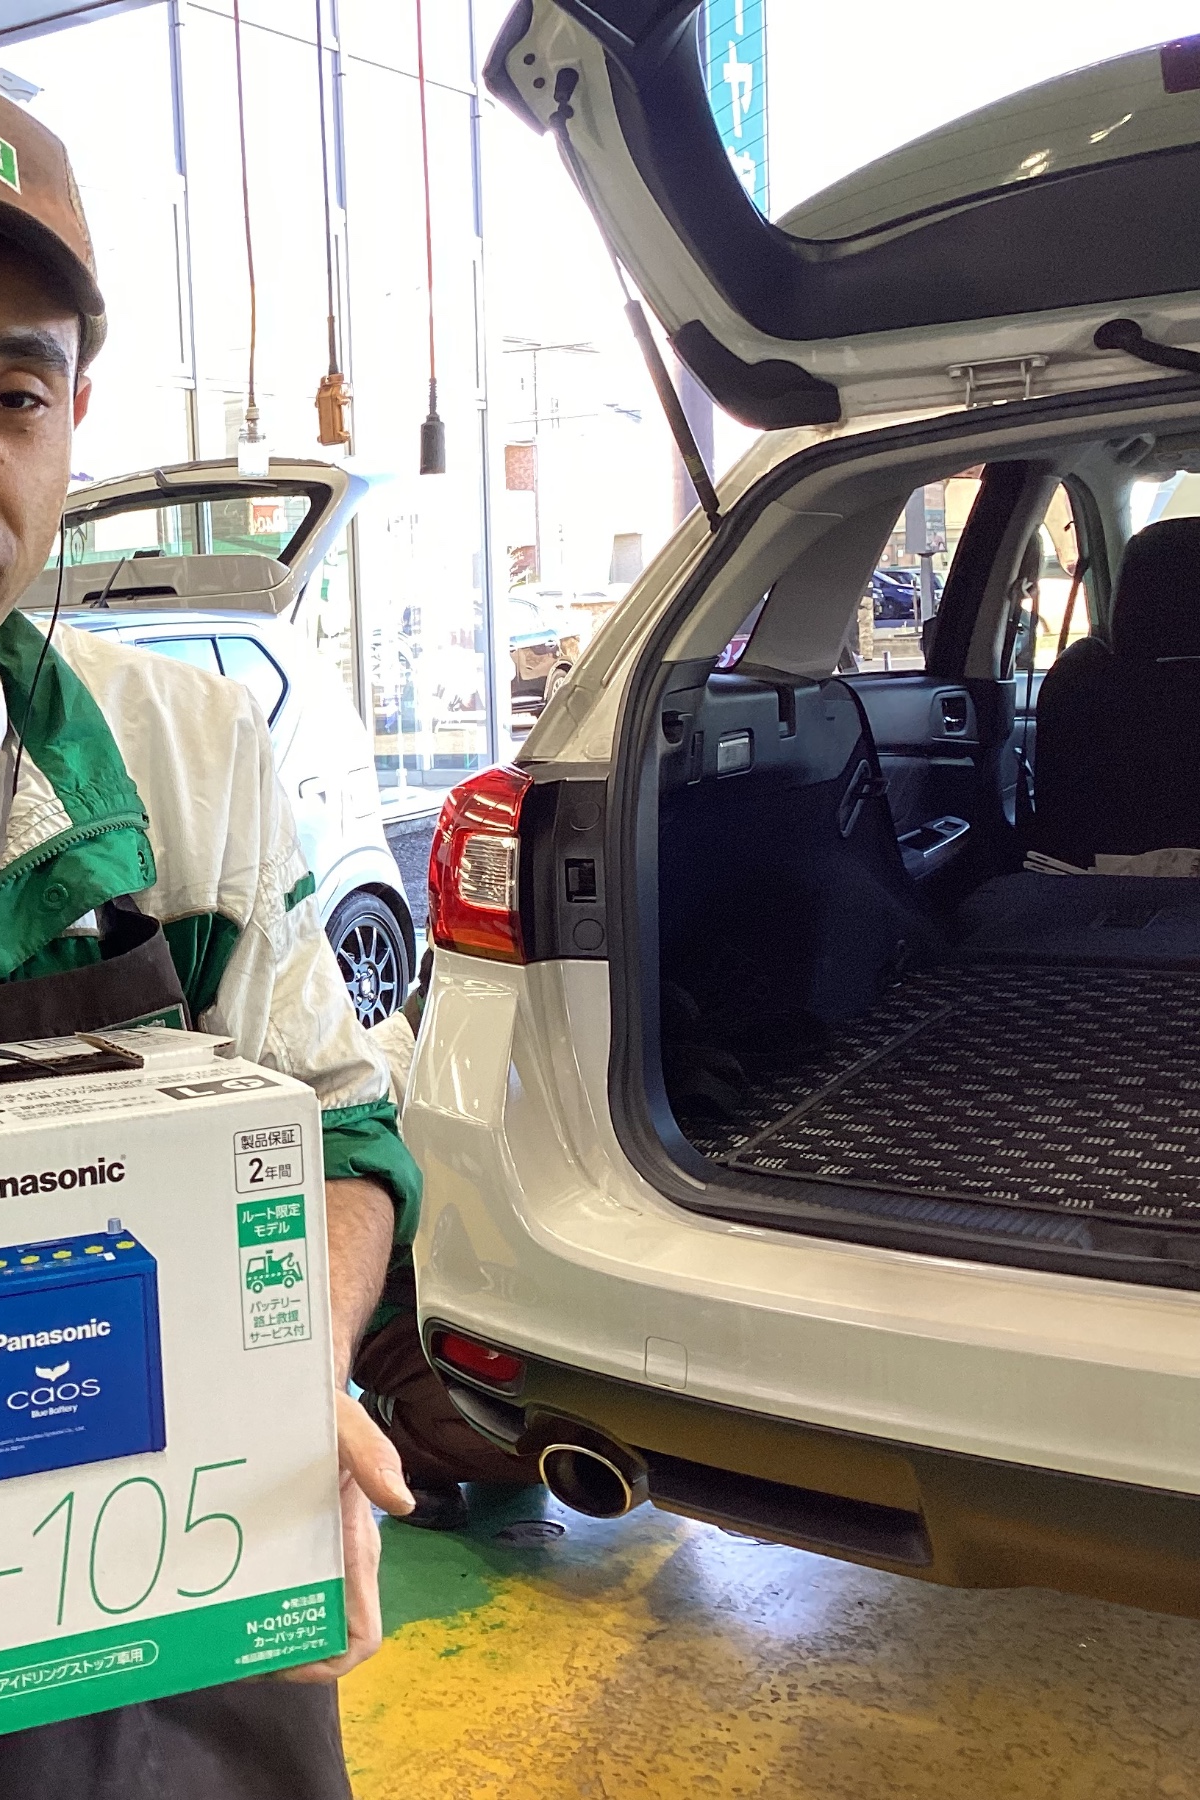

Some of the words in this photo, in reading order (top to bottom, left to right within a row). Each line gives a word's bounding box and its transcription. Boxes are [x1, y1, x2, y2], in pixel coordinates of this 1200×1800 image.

[175, 1086, 217, 1098] L
[240, 1129, 295, 1150] 製品保証
[241, 1203, 301, 1224] ルート限定
[254, 1222, 290, 1238] モデル
[250, 1298, 301, 1313] バッテリー
[253, 1310, 299, 1329] 路上救援
[250, 1324, 305, 1343] サービス付
[7, 1378, 101, 1410] caos
[31, 1407, 49, 1419] Blue
[49, 1404, 79, 1416] Battery
[246, 1606, 327, 1635] N-Q105/Q4
[253, 1625, 327, 1648] カーバッテリー
